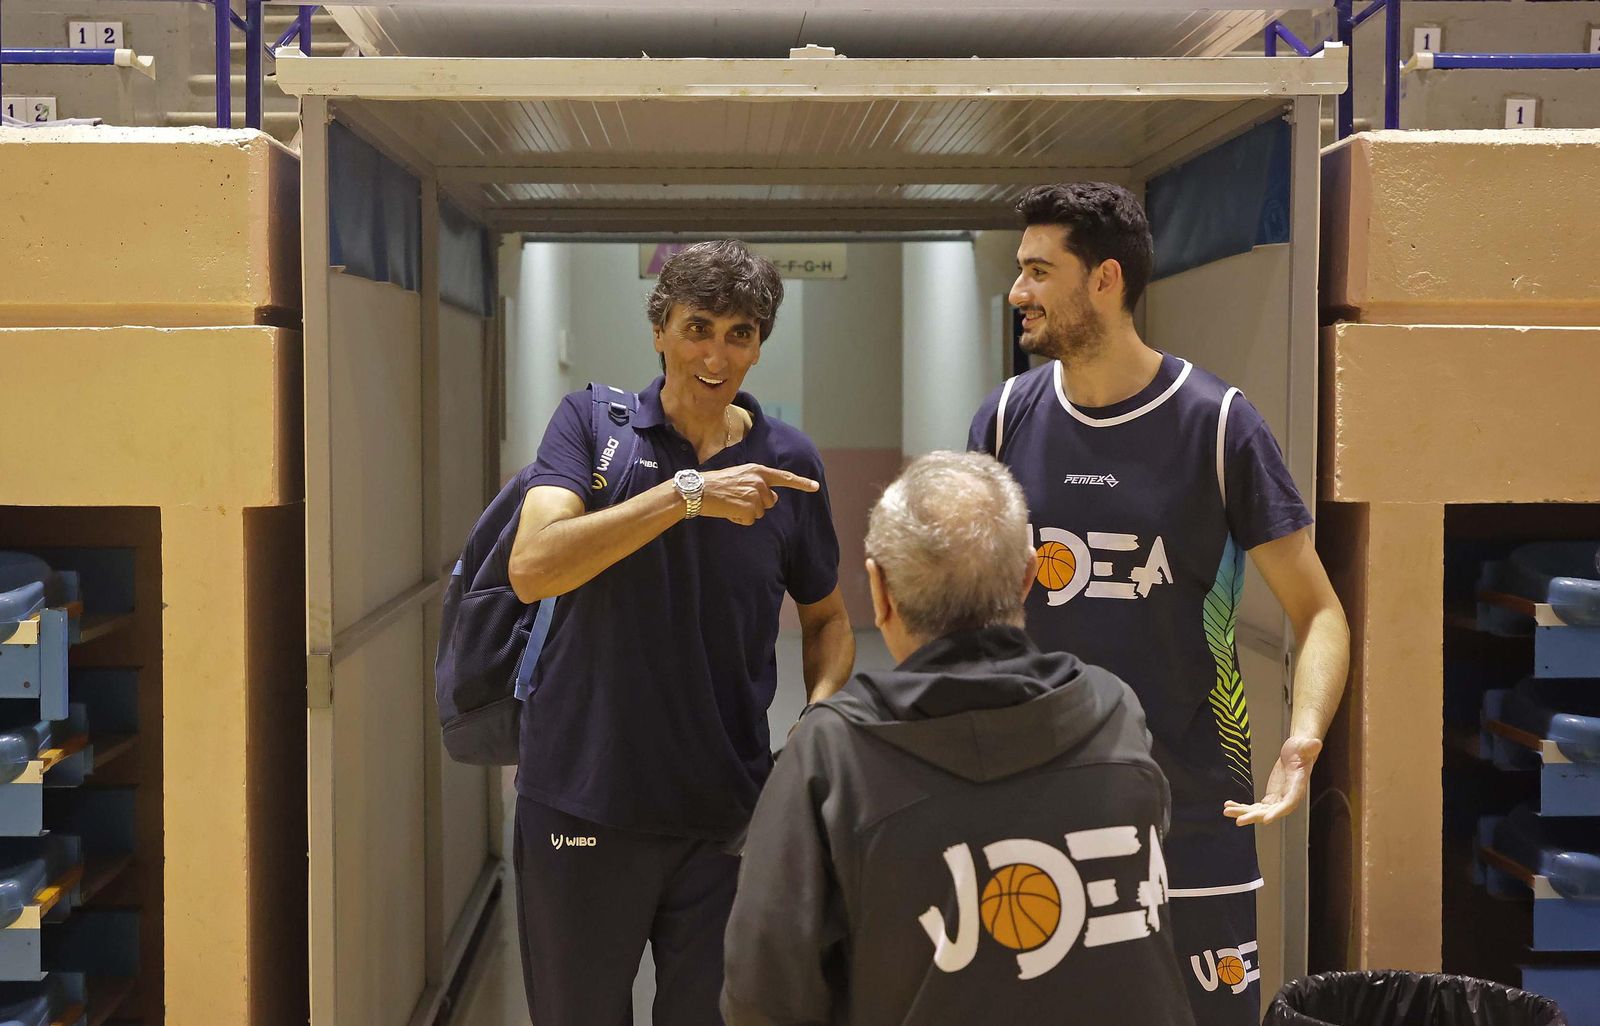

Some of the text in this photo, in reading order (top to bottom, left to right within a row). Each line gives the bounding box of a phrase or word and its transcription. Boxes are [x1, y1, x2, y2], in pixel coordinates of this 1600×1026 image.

[79, 27, 116, 45] 1 2
[1424, 33, 1432, 50] 1
[34, 103, 50, 122] 2
[1517, 106, 1525, 124] 1
[596, 437, 620, 472] WIBO
[1064, 474, 1106, 485] PENTEX
[1026, 524, 1174, 607] DEA
[565, 836, 597, 847] WIBO
